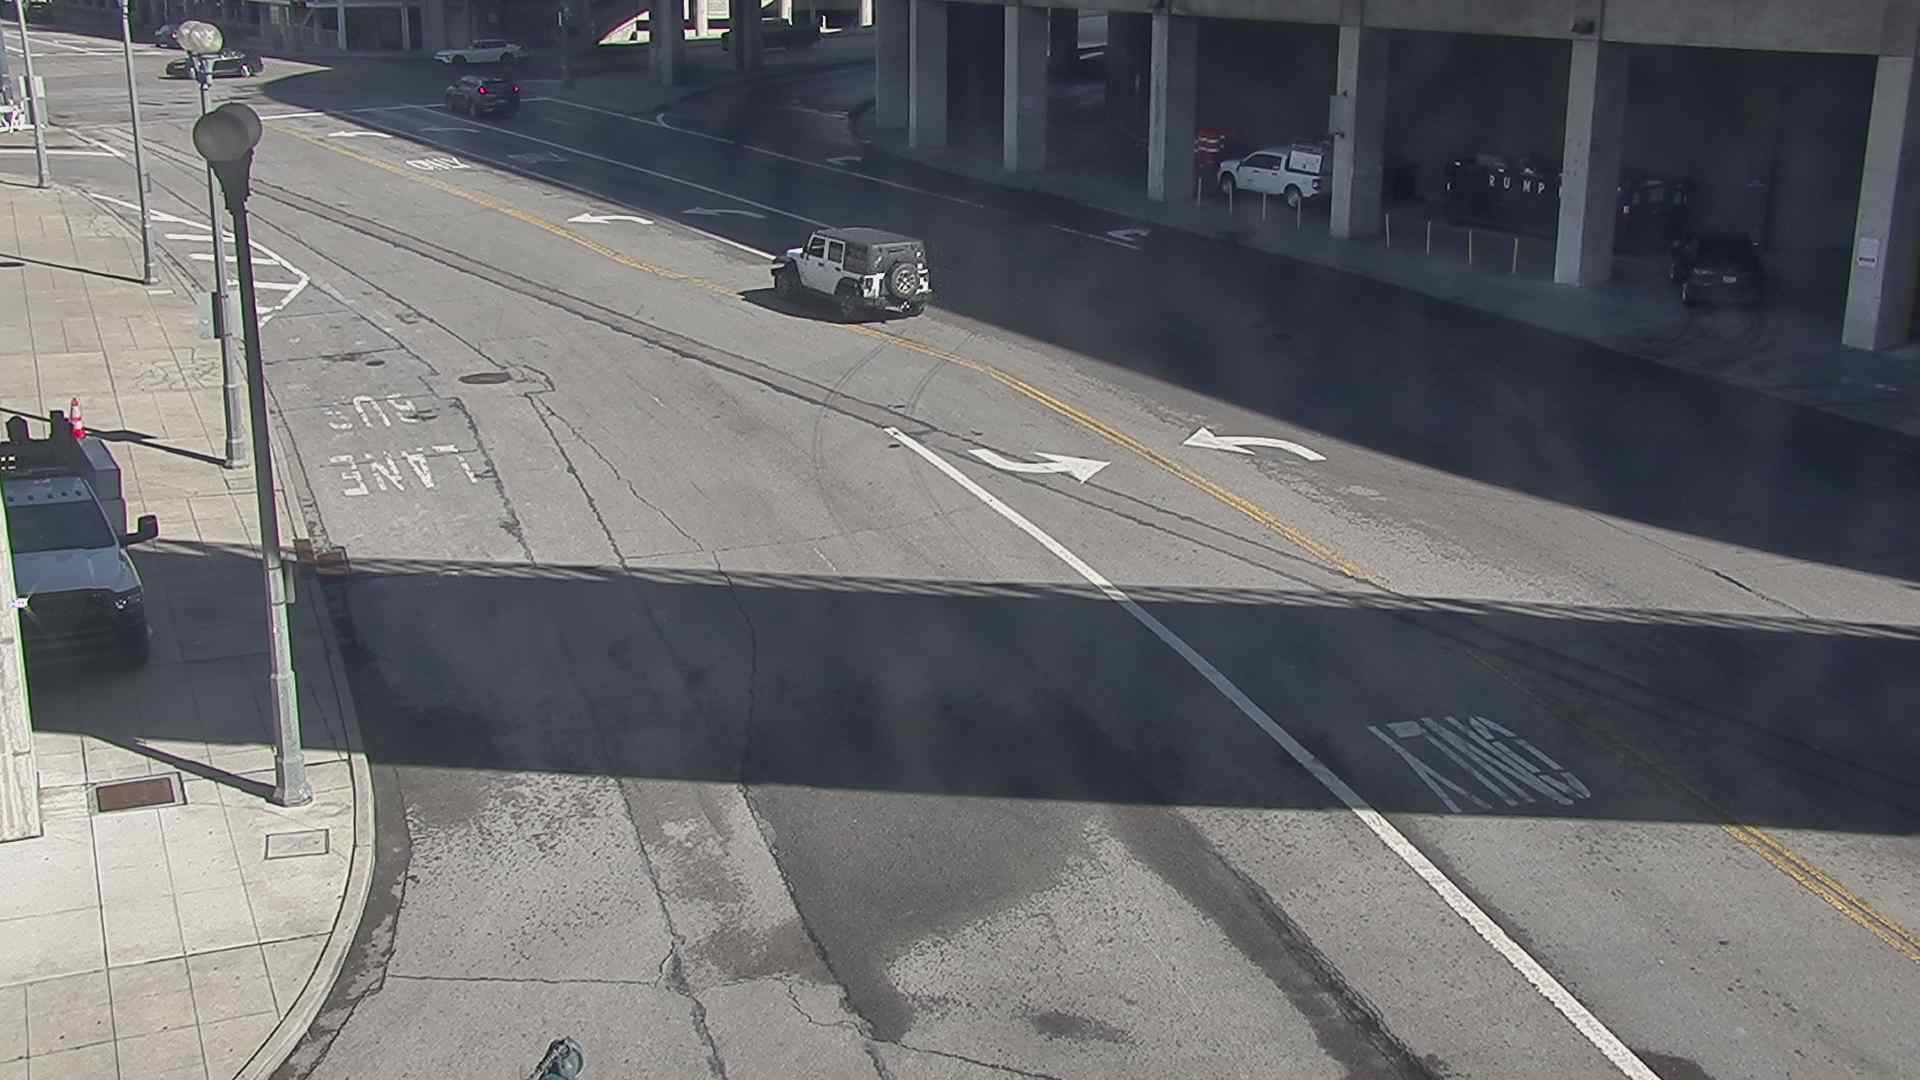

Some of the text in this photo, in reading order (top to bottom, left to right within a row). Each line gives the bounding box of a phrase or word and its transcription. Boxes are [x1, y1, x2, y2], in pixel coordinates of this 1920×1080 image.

[1488, 175, 1562, 198] RUMP
[329, 445, 478, 497] LANE
[1367, 715, 1592, 813] ONLY
